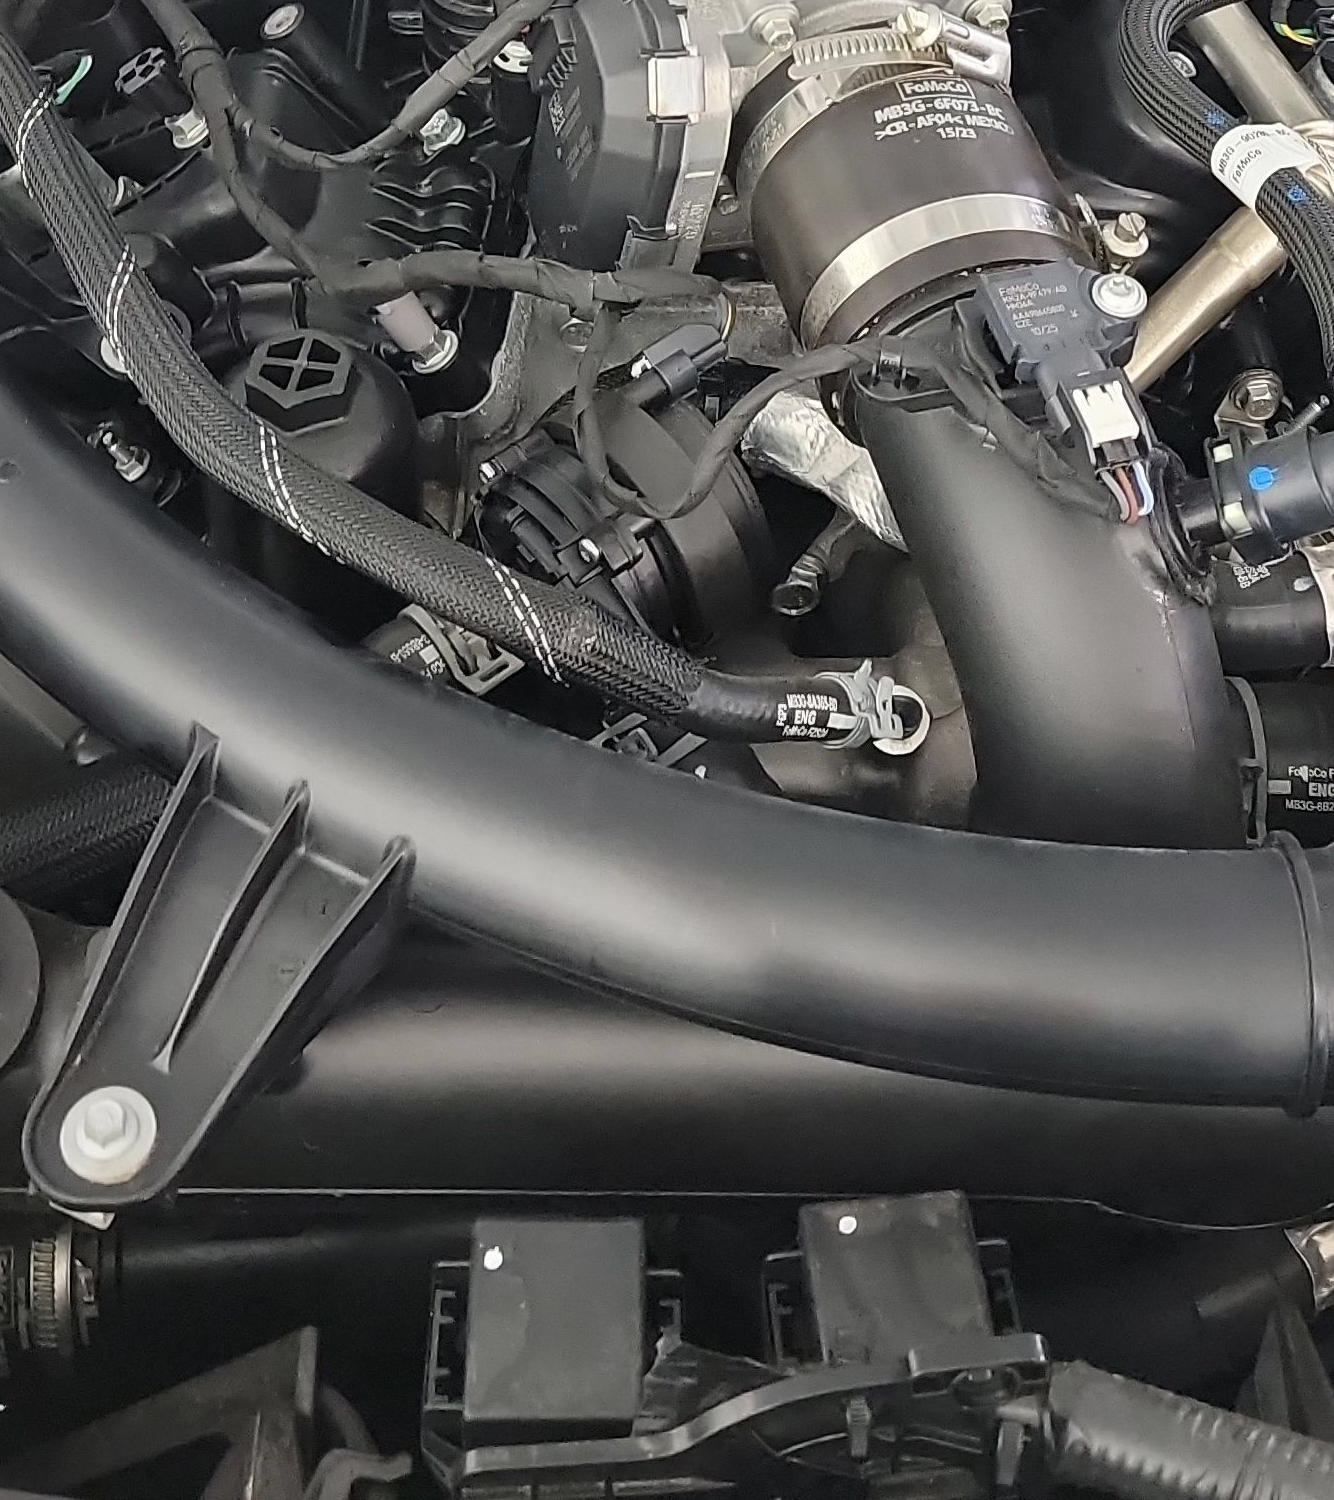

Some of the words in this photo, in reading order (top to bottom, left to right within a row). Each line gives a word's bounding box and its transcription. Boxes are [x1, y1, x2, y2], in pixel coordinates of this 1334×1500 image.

[903, 81, 967, 94] FoMoCo
[874, 98, 1006, 125] MB3G-6F073-BC
[937, 126, 978, 139] 15/23
[794, 709, 817, 725] ENG
[1288, 766, 1327, 778] FooCo
